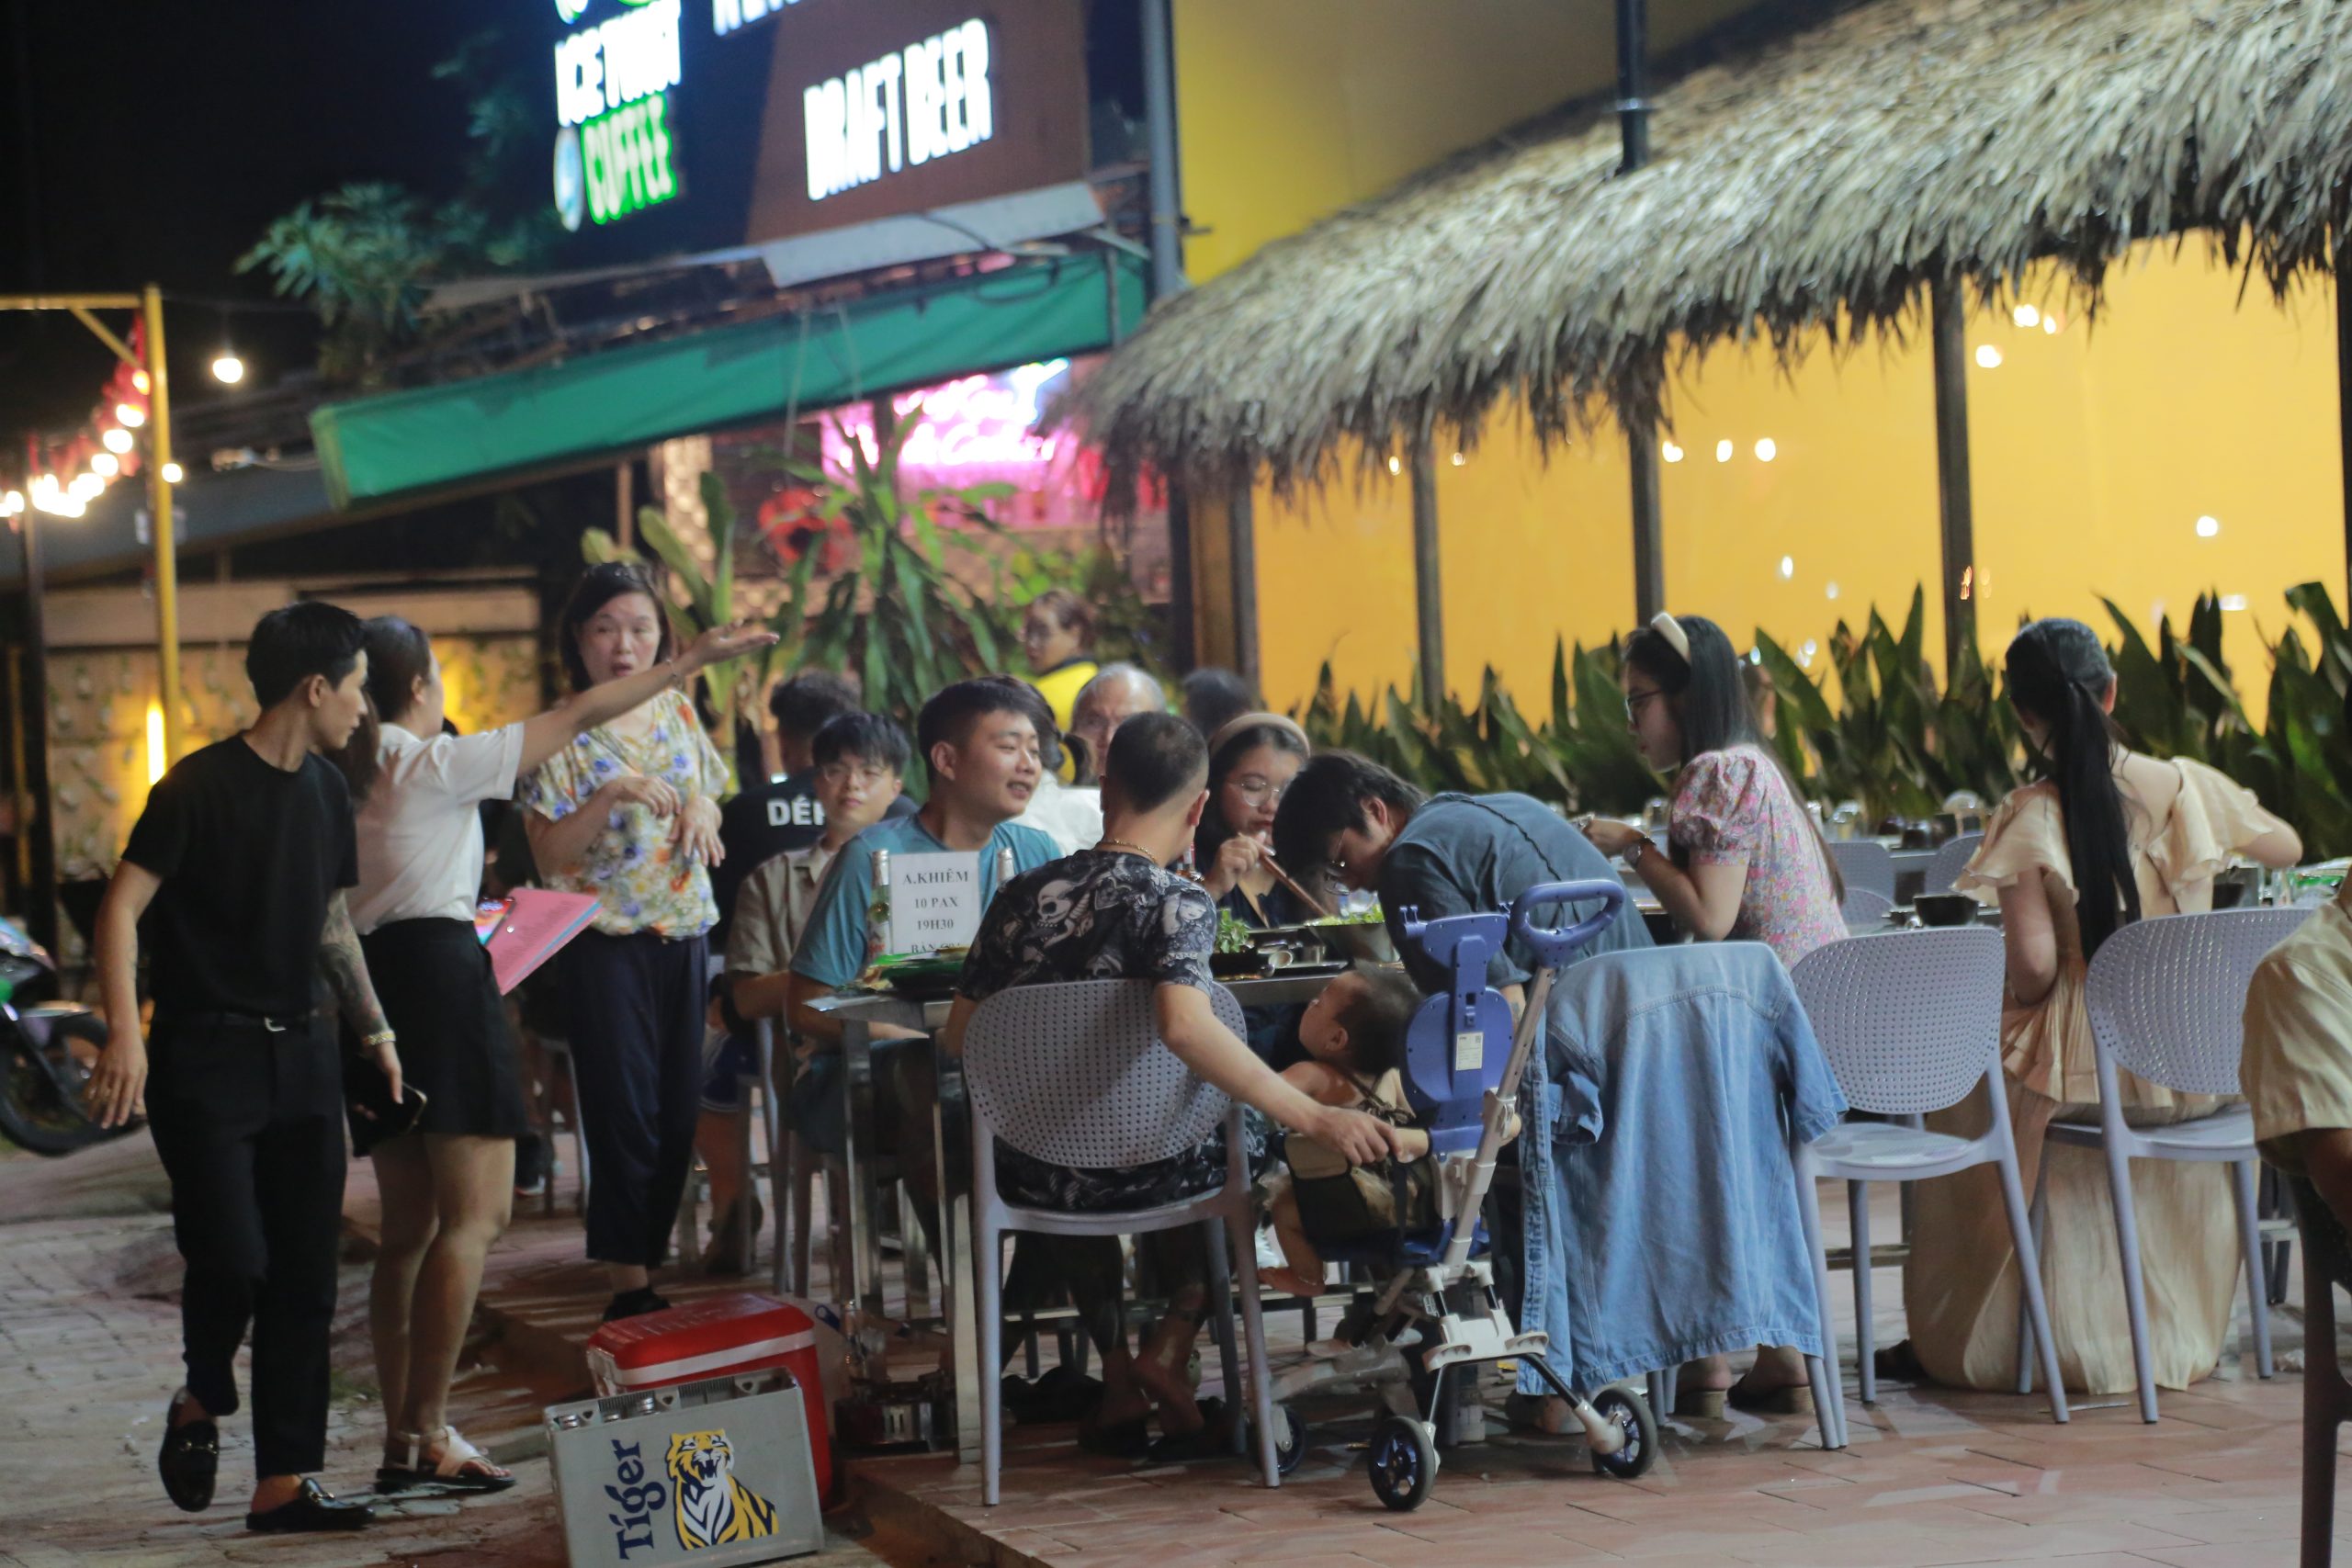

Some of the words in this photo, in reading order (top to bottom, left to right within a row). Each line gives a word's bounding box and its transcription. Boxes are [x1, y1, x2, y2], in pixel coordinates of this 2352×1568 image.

[903, 18, 991, 165] BEER
[914, 898, 927, 908] 10
[931, 897, 958, 908] PAX
[917, 919, 954, 931] 19H30
[605, 1439, 666, 1560] Tiger
